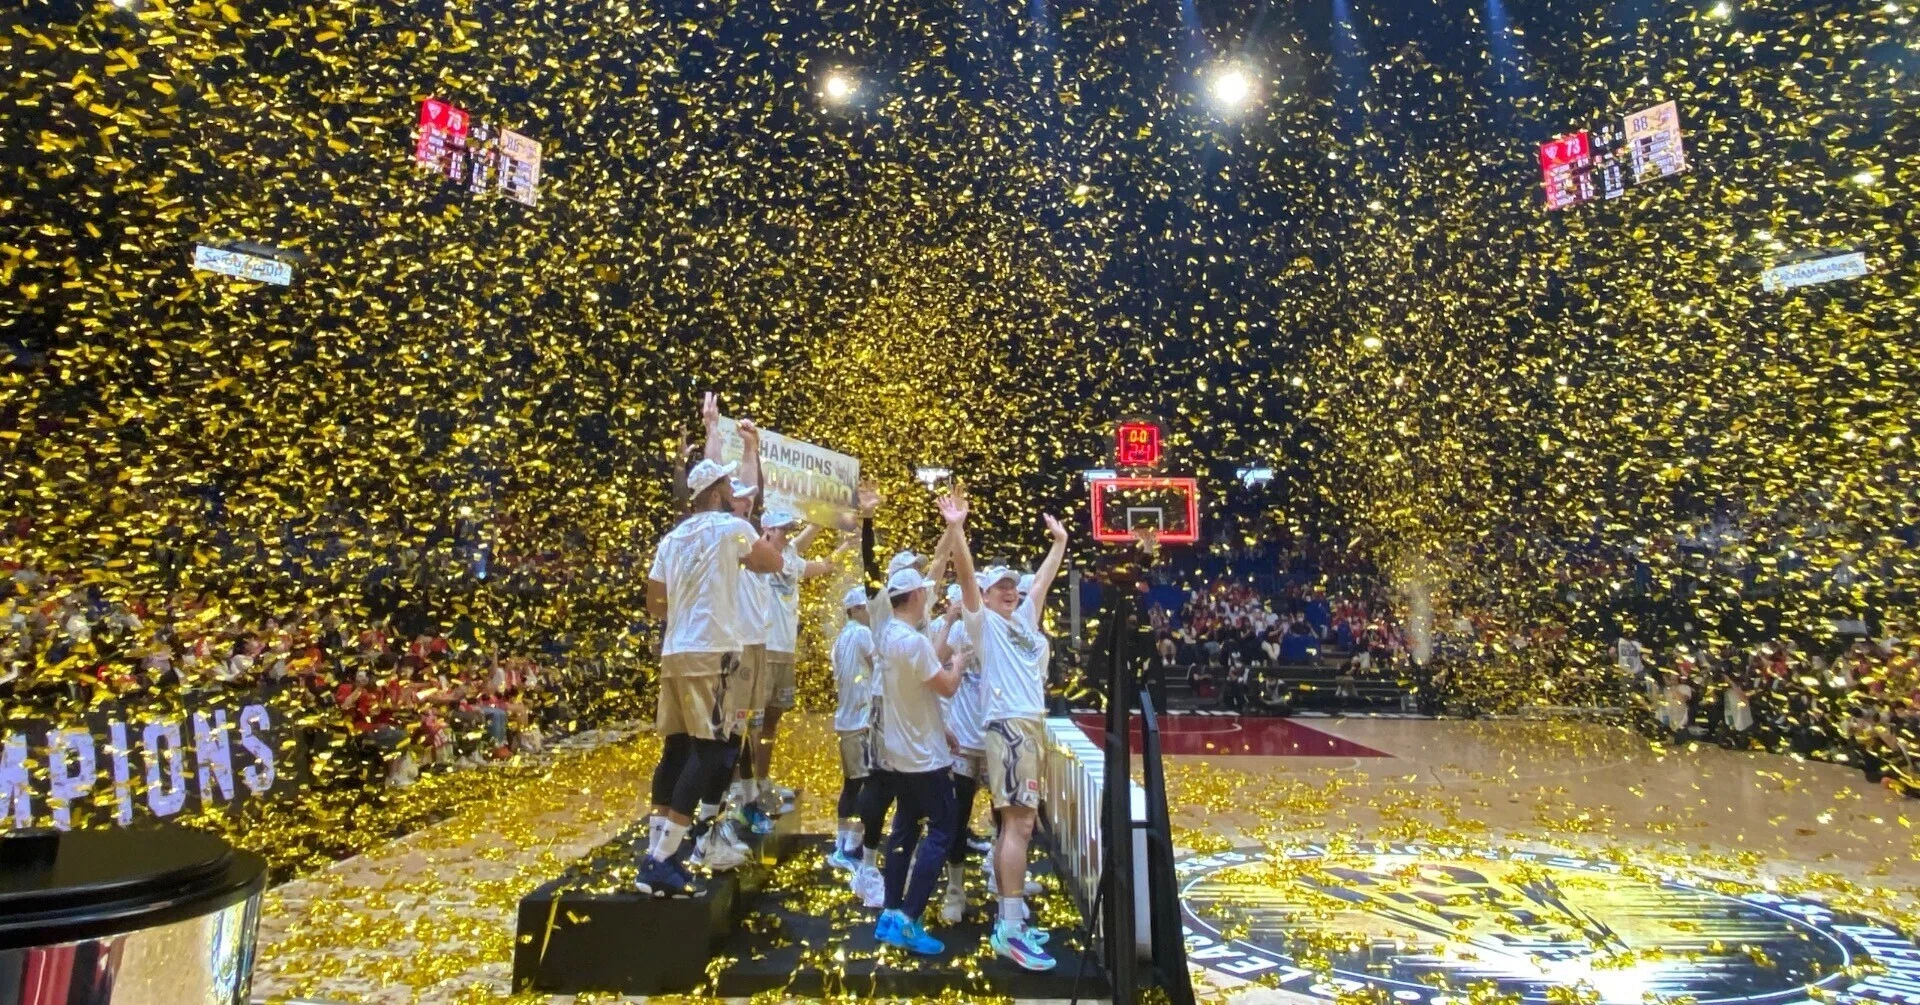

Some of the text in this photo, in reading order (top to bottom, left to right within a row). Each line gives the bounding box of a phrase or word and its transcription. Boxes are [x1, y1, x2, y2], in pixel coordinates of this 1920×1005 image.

[1633, 115, 1649, 132] 88
[1564, 137, 1581, 157] 73
[1130, 429, 1147, 443] 0.0
[759, 439, 833, 477] HAMPIONS
